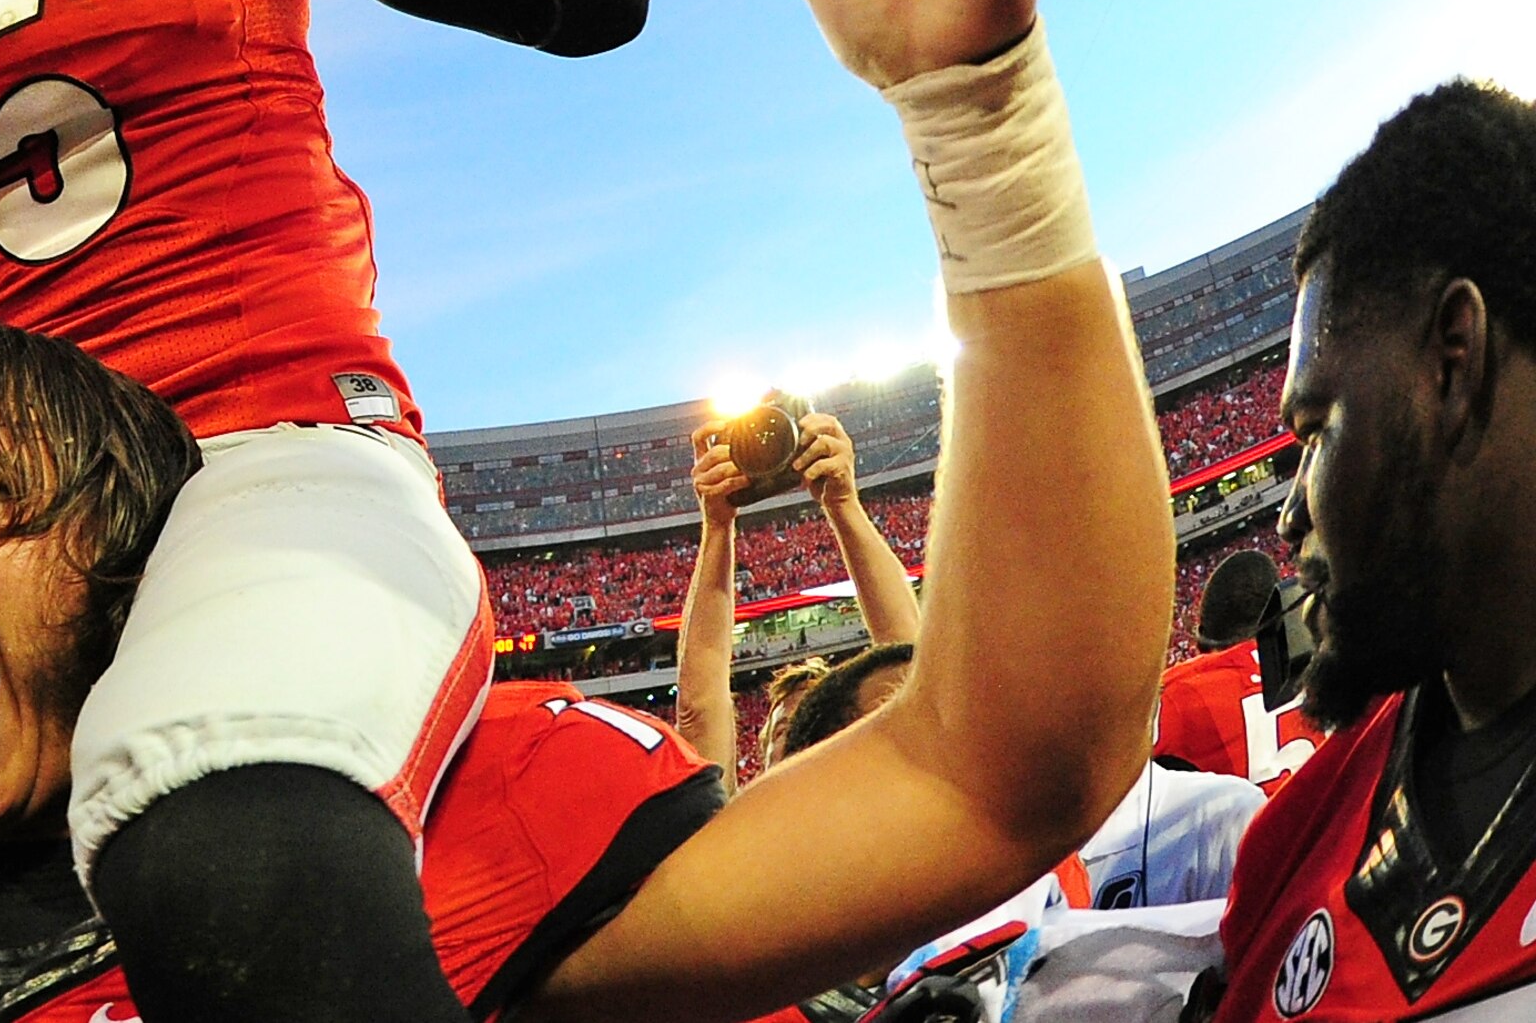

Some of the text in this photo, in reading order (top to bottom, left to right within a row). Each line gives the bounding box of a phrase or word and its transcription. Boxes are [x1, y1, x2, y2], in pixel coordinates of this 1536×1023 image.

[349, 378, 377, 393] 38
[1419, 907, 1463, 950] G
[1276, 915, 1331, 1014] SEC
